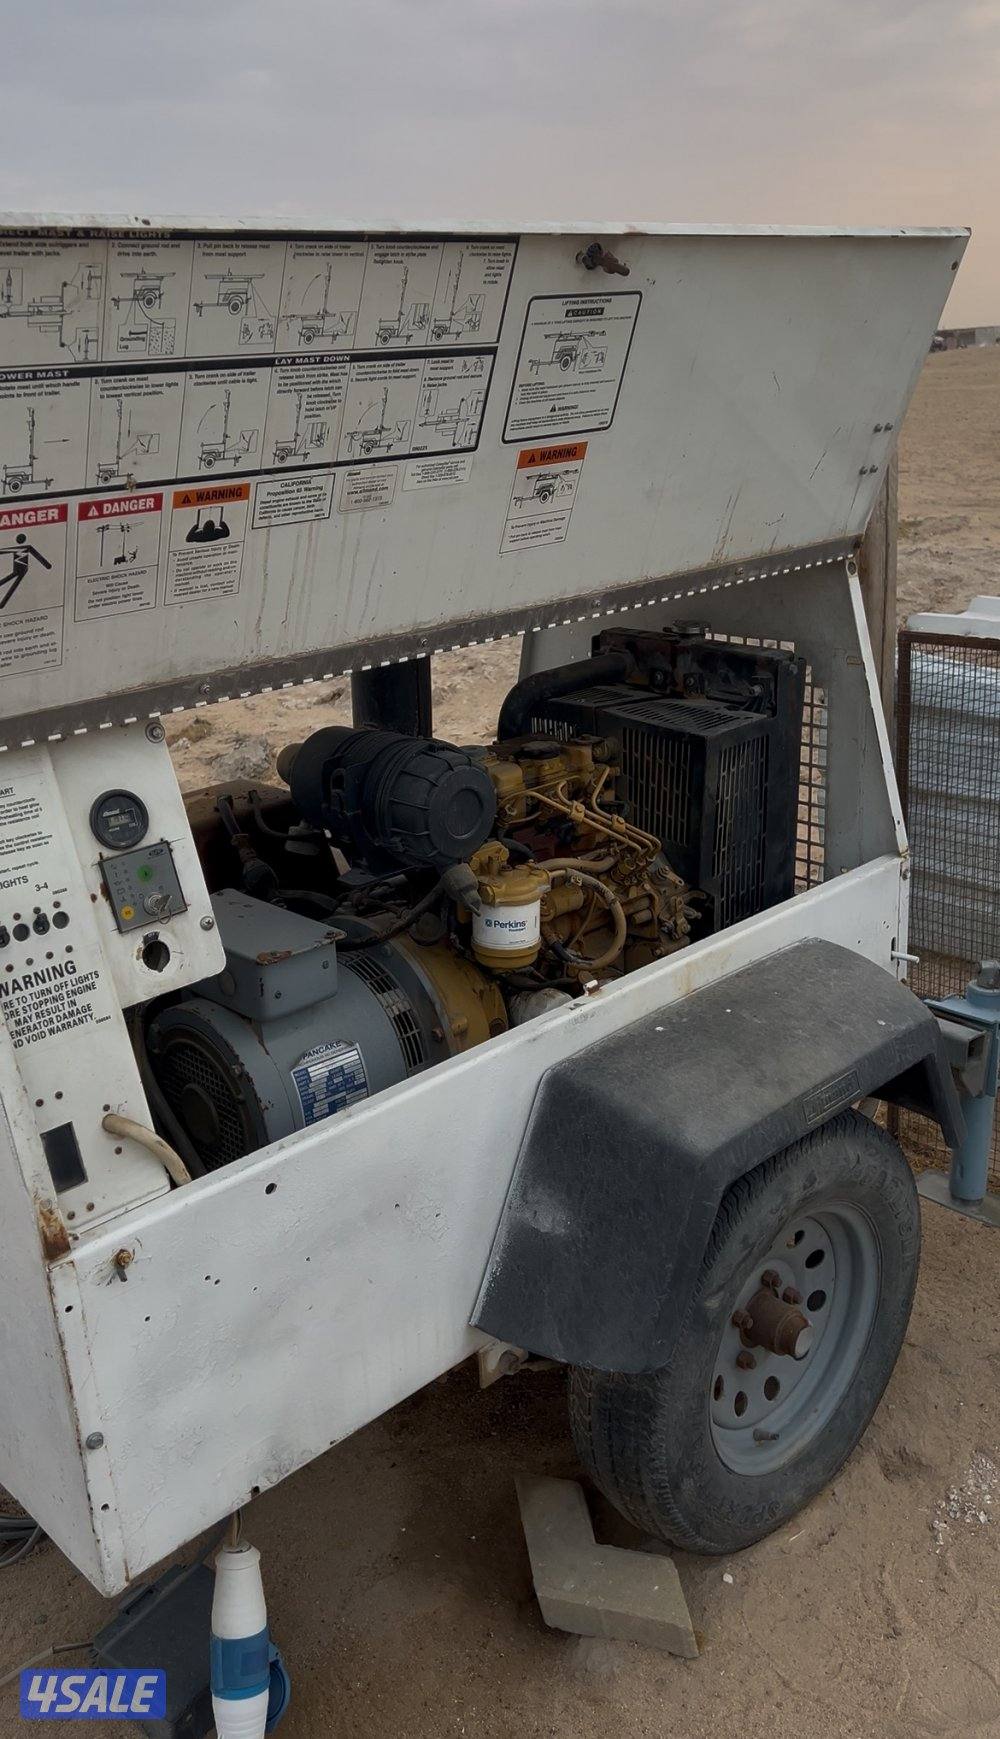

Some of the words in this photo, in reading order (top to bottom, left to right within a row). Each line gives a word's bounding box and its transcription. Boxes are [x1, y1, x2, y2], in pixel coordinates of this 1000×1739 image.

[275, 357, 293, 365] LAY
[295, 356, 321, 364] MAST
[323, 354, 350, 363] DOWN
[36, 370, 69, 378] MAST
[539, 446, 578, 462] WARNING
[280, 480, 312, 488] CALIFORNIA
[196, 487, 243, 503] WARNING
[103, 498, 155, 515] DANGER
[0, 508, 59, 526] ANGER
[87, 575, 111, 584] ELECTRIC
[3, 619, 24, 627] SHOCK
[25, 615, 48, 623] HAZARD
[0, 786, 14, 796] ART
[34, 882, 49, 892] 3-4
[494, 919, 526, 928] Perkins
[15, 995, 28, 1006] TO
[28, 986, 53, 1001] TURN
[53, 980, 69, 993] OFF
[69, 970, 100, 987] LIGHTS
[21, 992, 65, 1015] STOPPING
[65, 981, 98, 999] ENGINE
[14, 1013, 33, 1028] MAY
[34, 1002, 66, 1020] RESULT
[67, 998, 78, 1009] IN
[9, 1016, 55, 1040] ENERATOR
[55, 1003, 93, 1023] DAMAGE
[24, 1030, 47, 1045] VOID
[47, 1012, 97, 1036] WARRANTY.
[302, 1040, 342, 1060] PANCAKE
